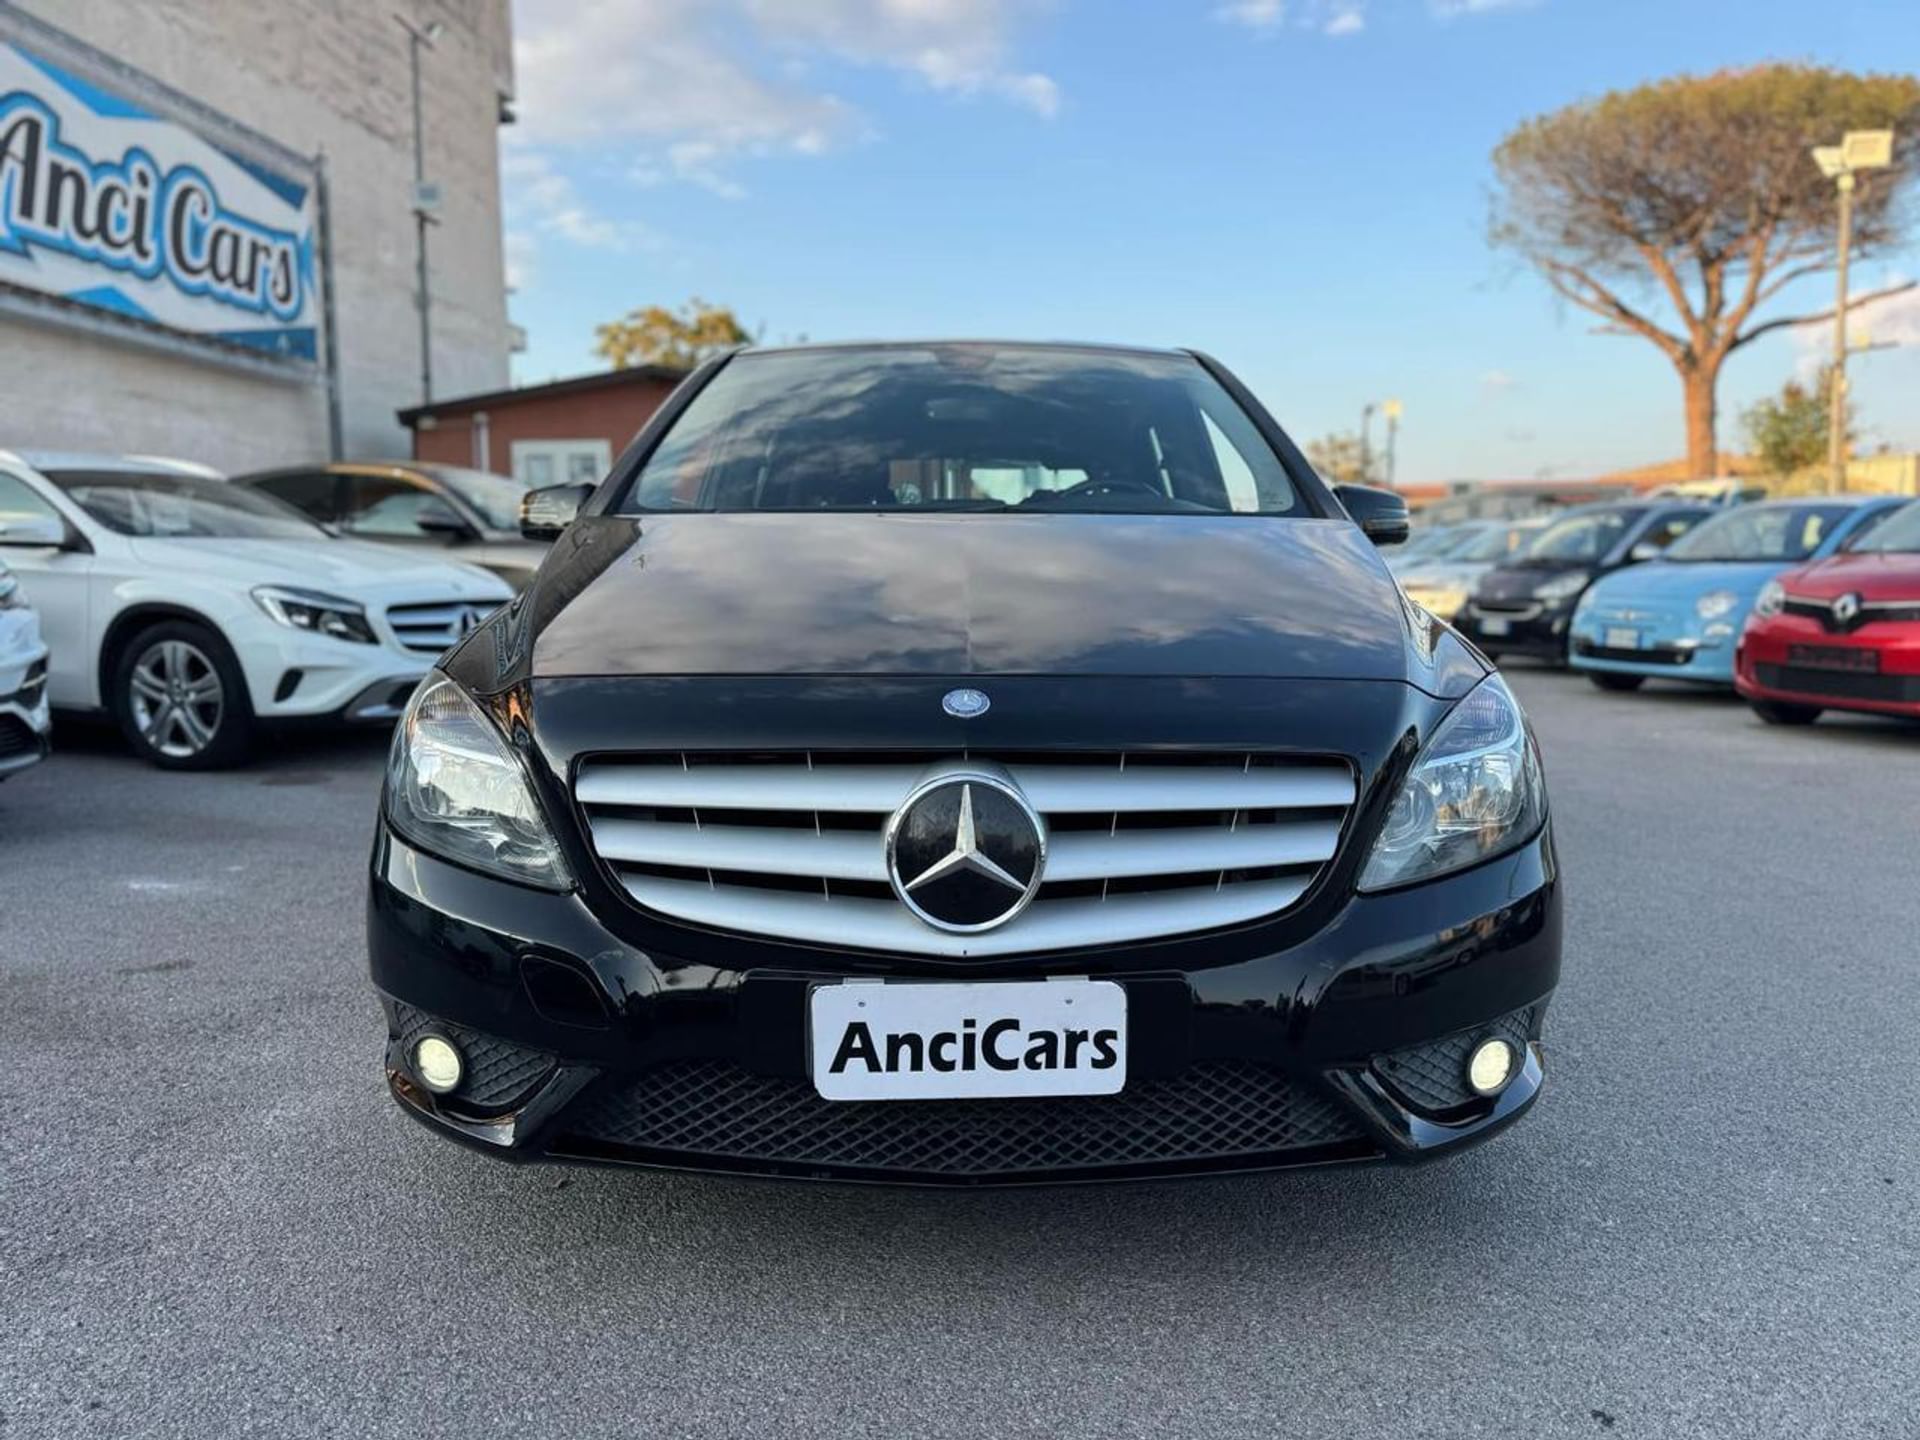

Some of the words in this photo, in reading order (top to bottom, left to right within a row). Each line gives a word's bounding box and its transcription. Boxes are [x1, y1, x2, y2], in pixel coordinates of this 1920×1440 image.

[0, 117, 150, 259] Anci
[171, 185, 292, 304] Cars
[828, 1018, 1118, 1074] AnciCars
